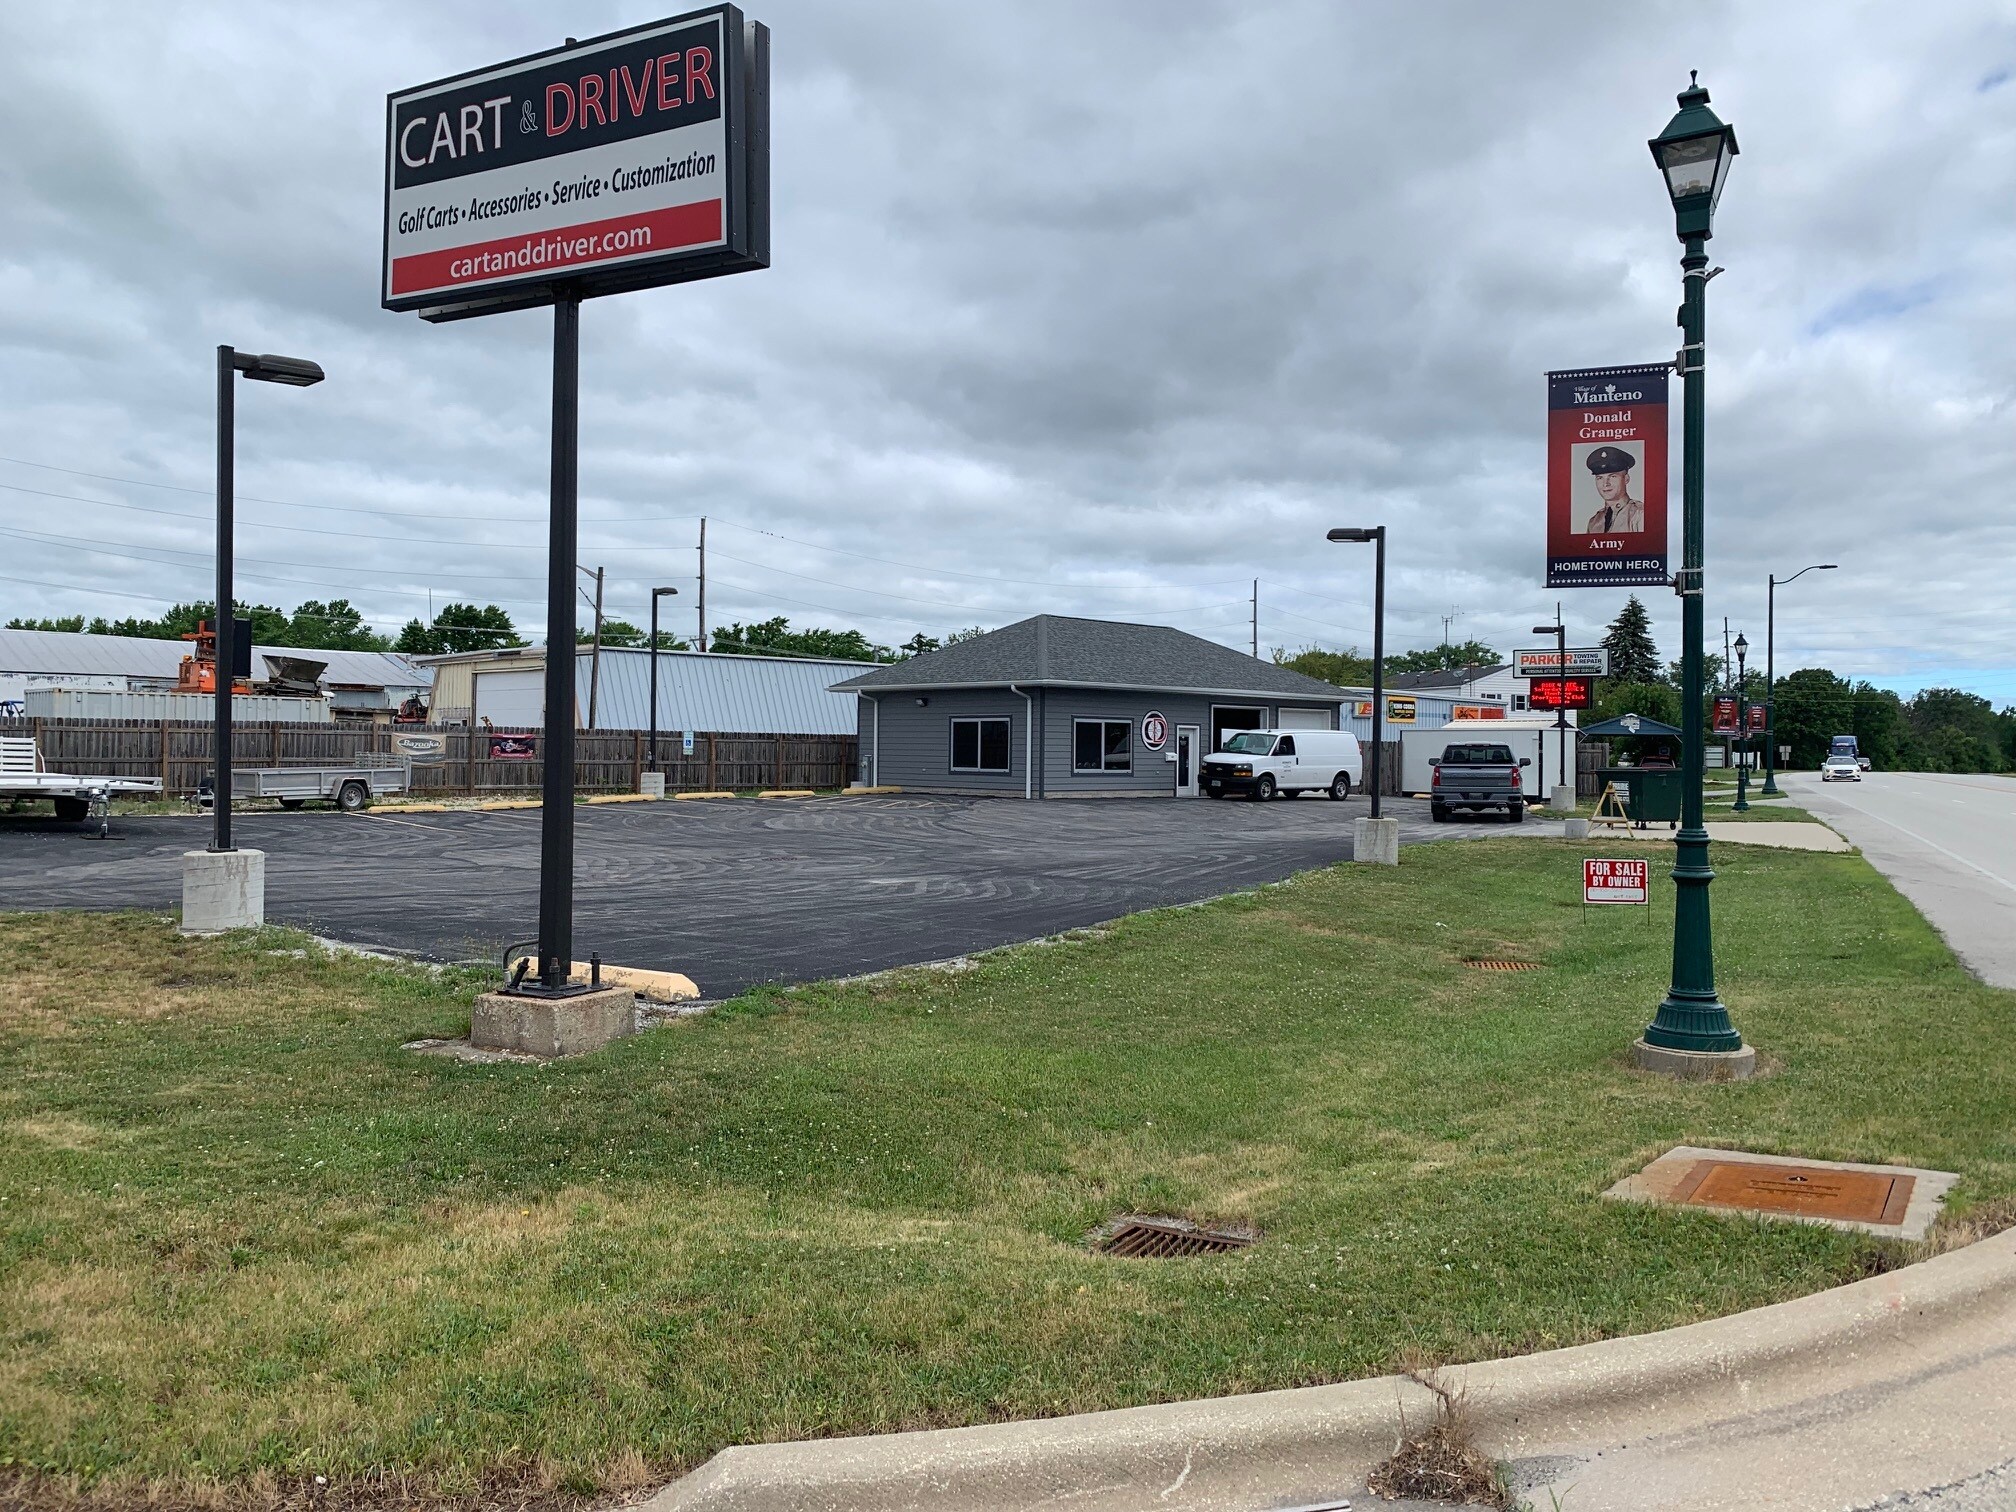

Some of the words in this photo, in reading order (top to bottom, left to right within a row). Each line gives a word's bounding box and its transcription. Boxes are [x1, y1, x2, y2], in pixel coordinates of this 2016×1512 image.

[400, 96, 511, 167] CART
[519, 100, 538, 134] &
[546, 46, 715, 137] DRIVER
[399, 211, 424, 235] Golf
[427, 204, 459, 230] Carts
[468, 187, 541, 221] Accessories
[552, 175, 600, 205] Service
[611, 151, 715, 194] Customization
[450, 224, 652, 279] cartanddriver.com
[1574, 390, 1642, 404] Manteno
[1584, 410, 1632, 424] Donald
[1579, 427, 1637, 440] Granger
[1589, 538, 1625, 550] Army
[1554, 560, 1623, 571] HOMETOWN
[1626, 560, 1660, 570] HERO
[402, 739, 439, 748] Bazooka
[1590, 862, 1610, 875] FOR
[1615, 862, 1643, 876] SALE
[1592, 876, 1604, 887] BY
[1608, 876, 1641, 887] OWNER
